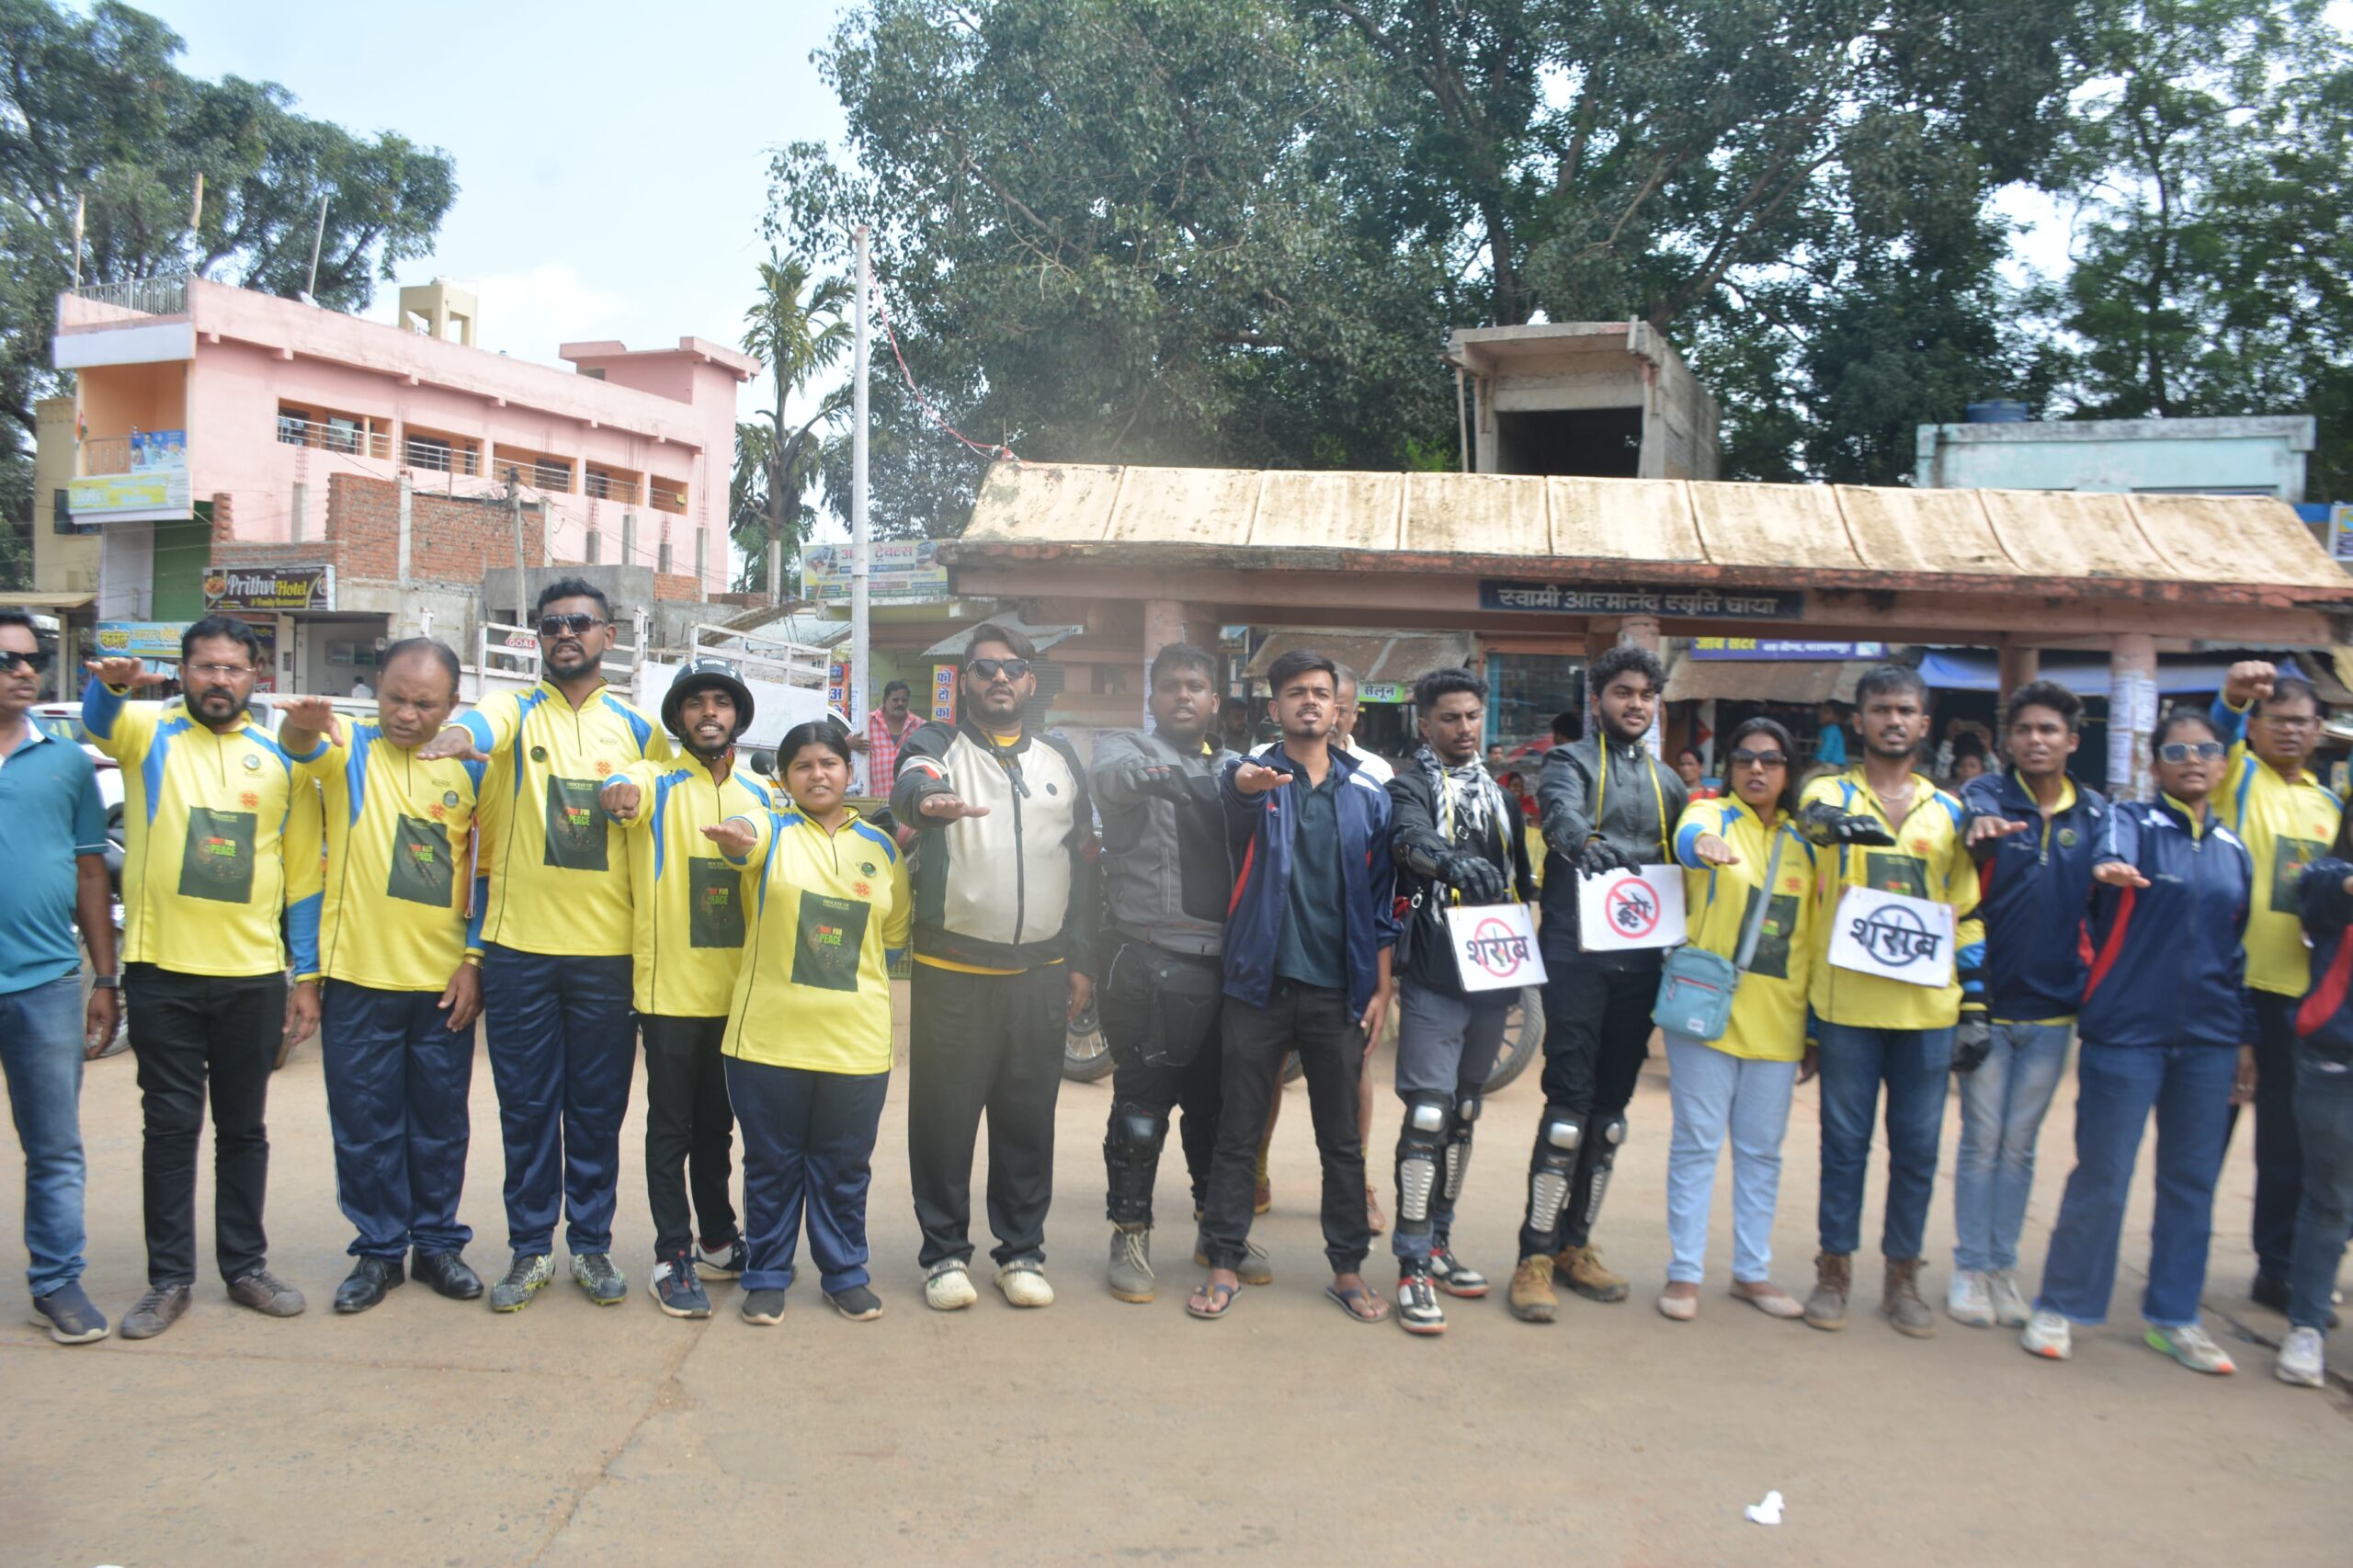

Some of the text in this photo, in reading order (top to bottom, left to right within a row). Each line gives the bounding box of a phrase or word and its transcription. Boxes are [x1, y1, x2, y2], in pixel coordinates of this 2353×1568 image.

[227, 574, 307, 596] Prithvi Hotel
[1497, 585, 1563, 608] स्वामी
[1564, 587, 1661, 611] आत्मानंद
[508, 639, 535, 647] GOAL
[1364, 684, 1395, 699] सेलून
[568, 815, 590, 826] PEACE
[819, 934, 843, 946] PEACE
[1849, 917, 1942, 960] शराब
[1465, 935, 1531, 966] शराब
